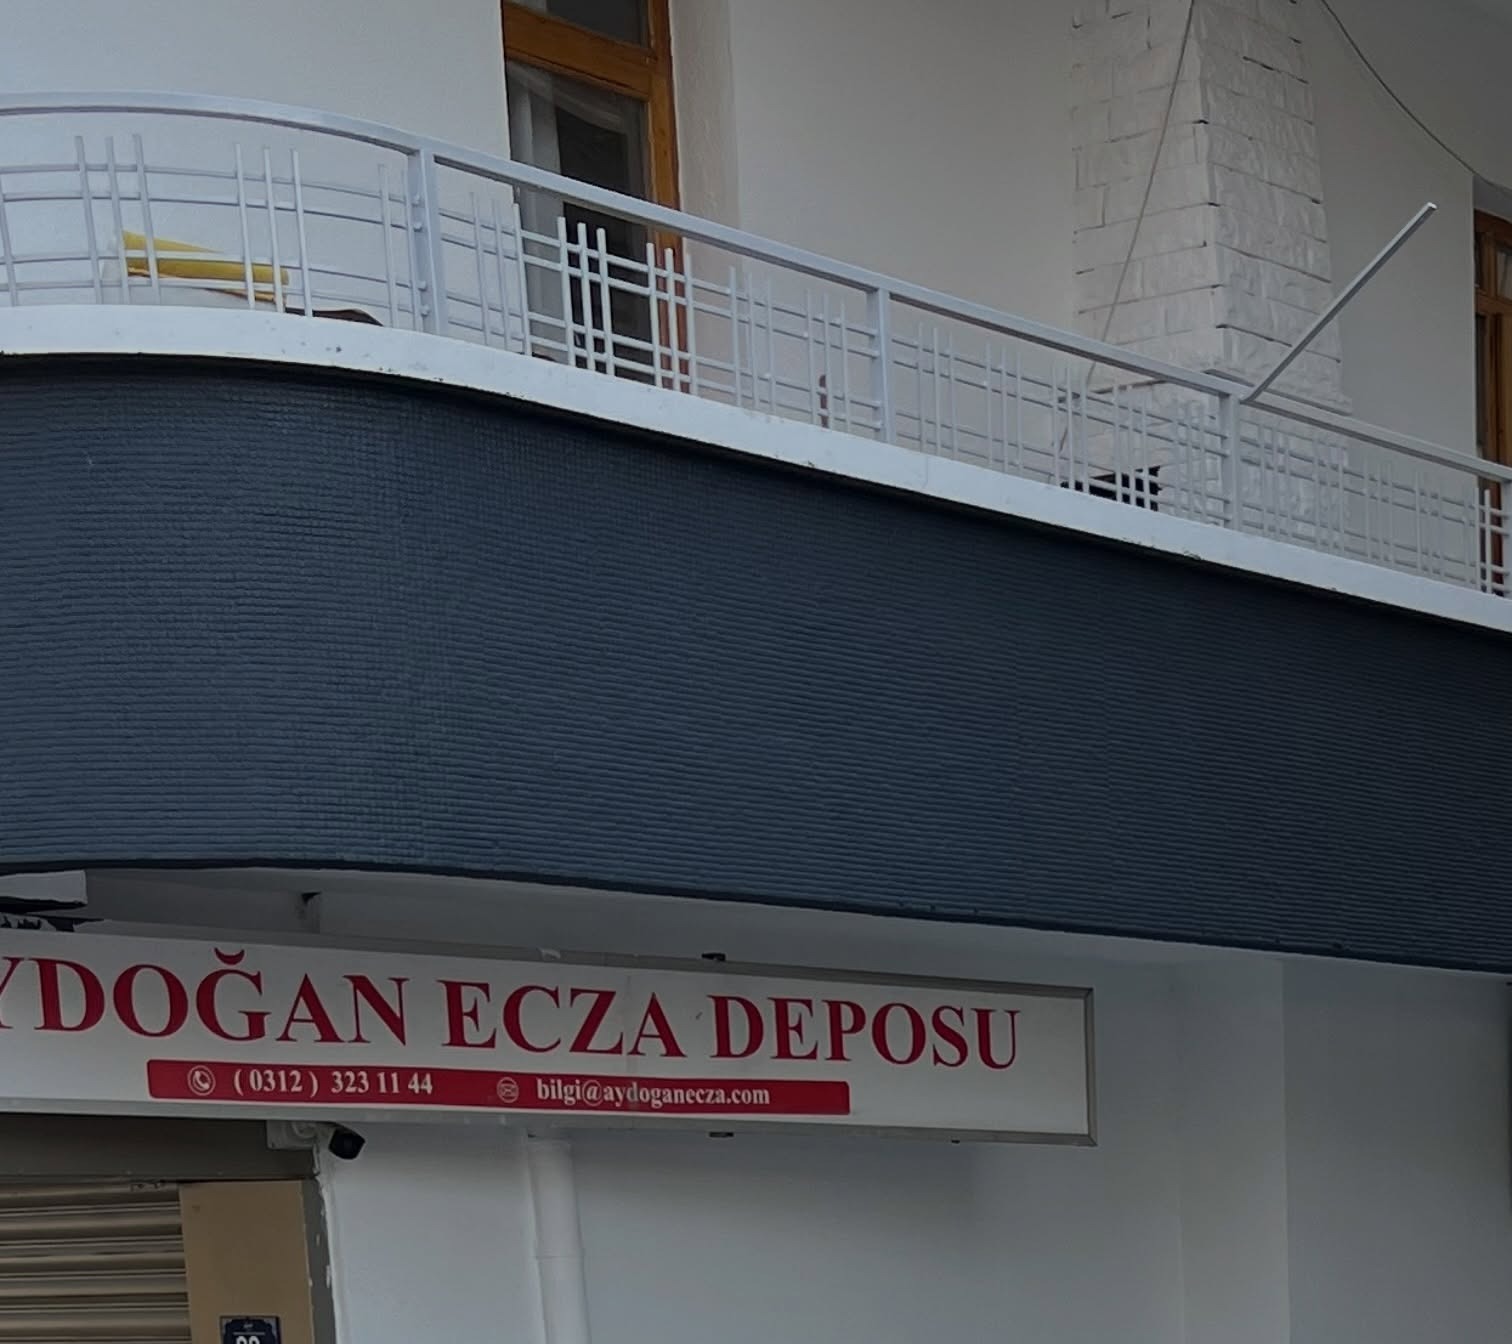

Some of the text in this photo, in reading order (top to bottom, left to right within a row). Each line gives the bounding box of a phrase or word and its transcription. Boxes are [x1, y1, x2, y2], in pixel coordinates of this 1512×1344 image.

[437, 979, 687, 1058] ECZA
[708, 994, 1021, 1070] DEPOSU
[331, 1071, 369, 1094] 323
[377, 1071, 399, 1094] 11
[408, 1073, 433, 1095] 44
[536, 1078, 770, 1109] bilgi@aydoganecza.com
